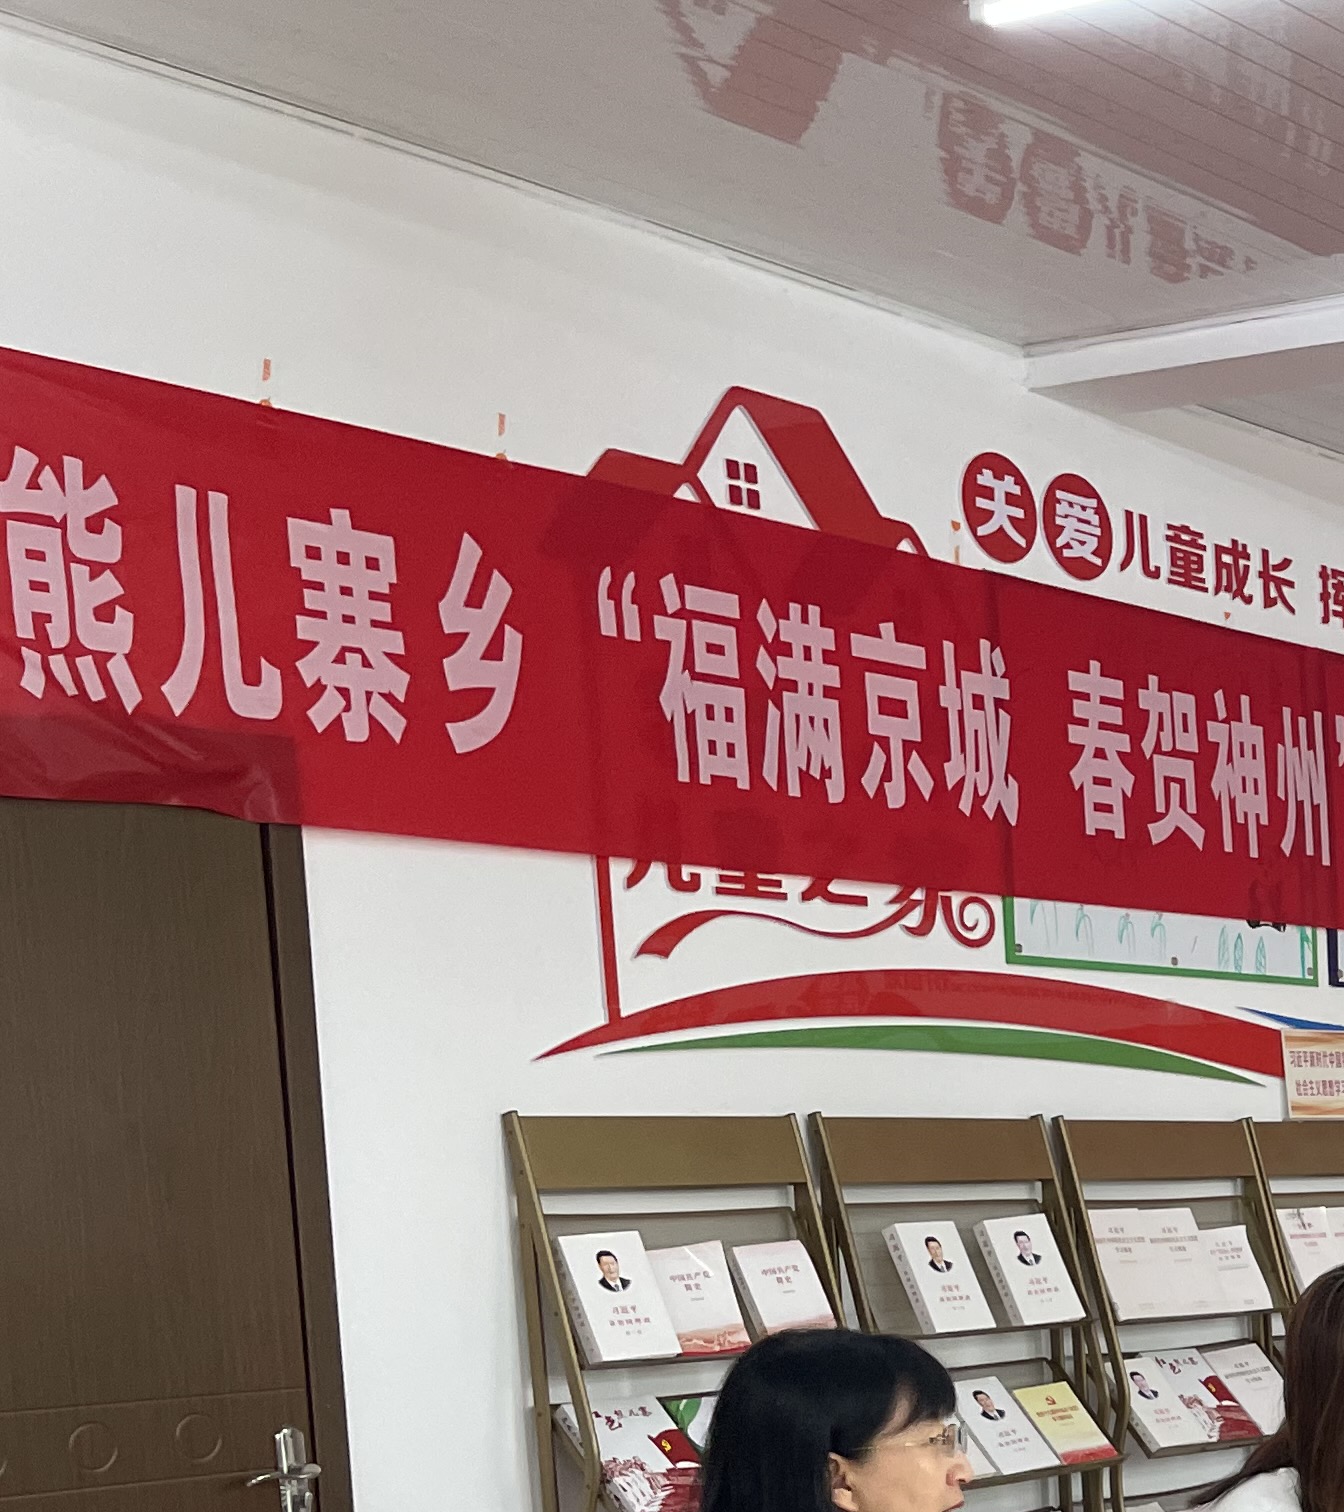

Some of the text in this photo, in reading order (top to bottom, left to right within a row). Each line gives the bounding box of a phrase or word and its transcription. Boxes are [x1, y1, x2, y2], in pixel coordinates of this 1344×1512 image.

[0, 446, 523, 754] 熊儿寨乡
[598, 567, 1019, 828] “福满京城
[975, 468, 1297, 615] 关爱儿童成长
